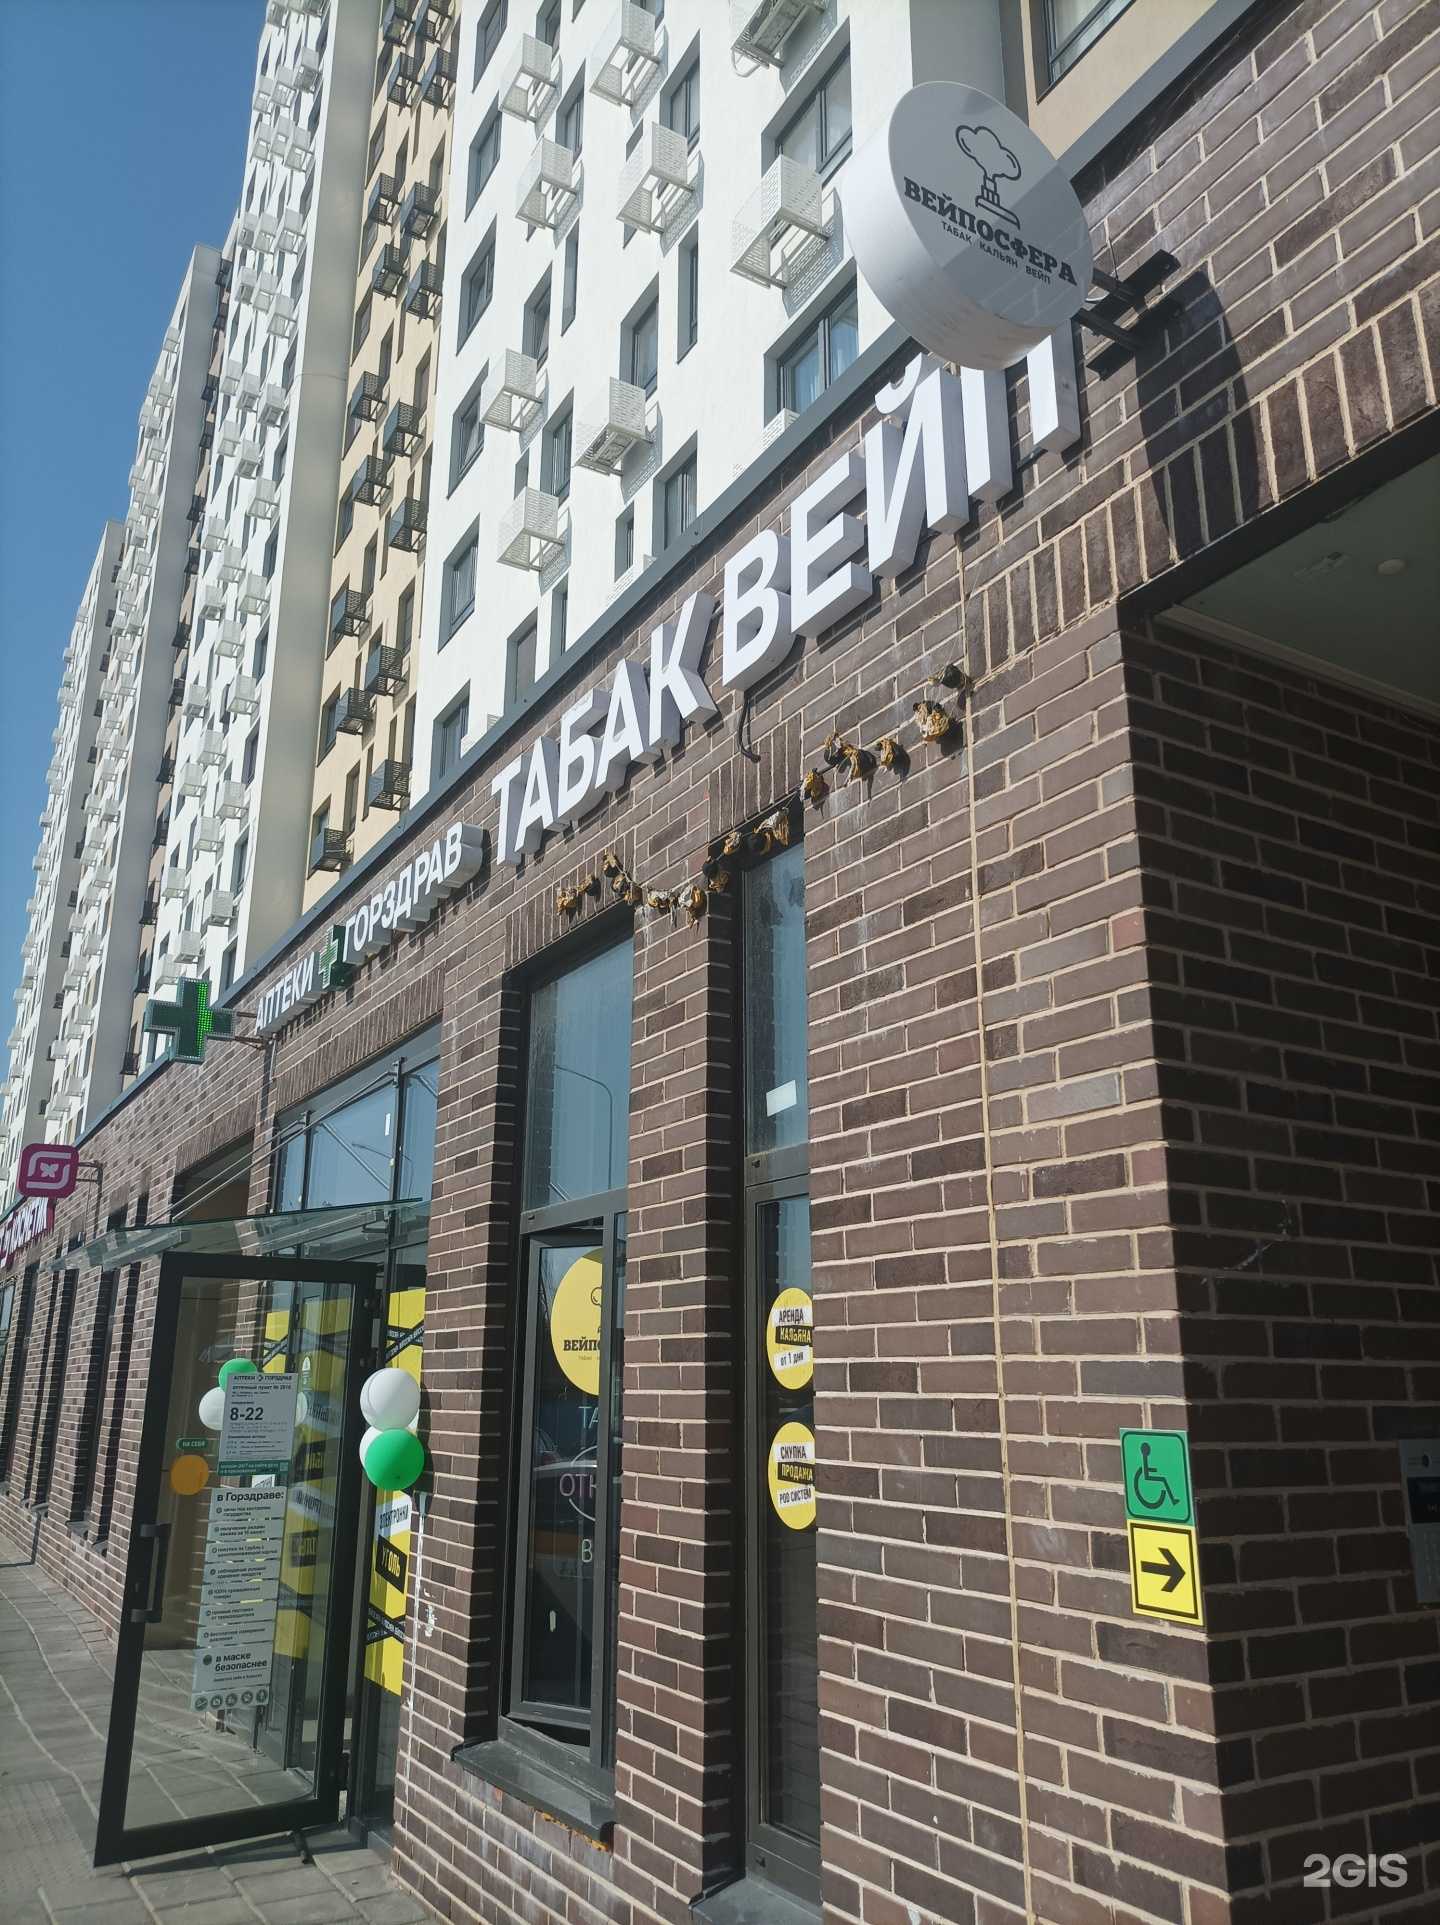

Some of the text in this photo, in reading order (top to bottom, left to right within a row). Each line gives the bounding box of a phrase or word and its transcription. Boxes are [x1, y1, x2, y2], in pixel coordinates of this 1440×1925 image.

[903, 176, 1078, 287] ВЕЙПОСФЕРА
[941, 219, 1052, 285] ТАБАК КАЛЬЯН ВЕЙП
[491, 591, 701, 867] ТАБАК
[254, 820, 466, 1036] АПТЕКИ ГОРЗДРАВ
[779, 1308, 804, 1324] АРЕНДА
[780, 1326, 812, 1344] КАЛЬЯНА
[229, 1407, 264, 1421] 8-22
[780, 1445, 807, 1460] СКУПКА
[781, 1463, 813, 1481] ПРОДАЖА
[216, 1491, 285, 1503] в Горздраве:
[222, 1652, 252, 1662] маске
[214, 1660, 268, 1672] безопаснее
